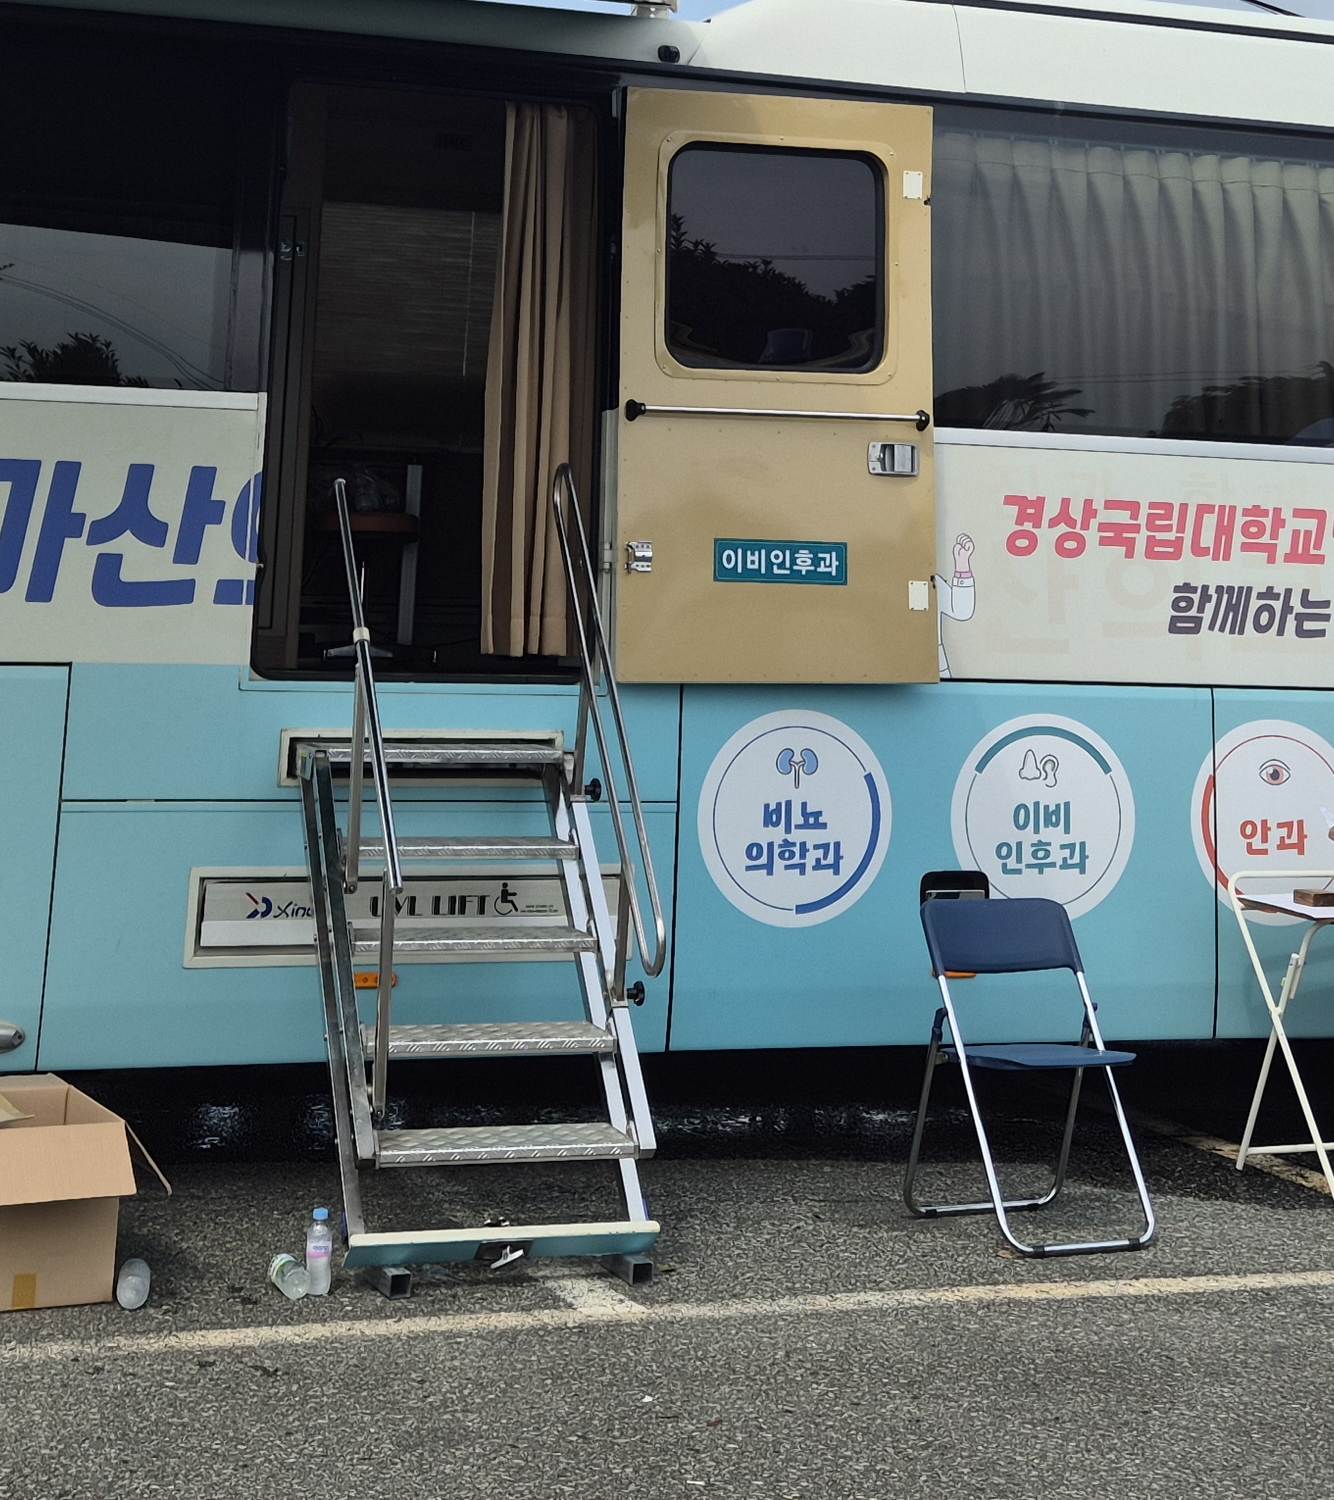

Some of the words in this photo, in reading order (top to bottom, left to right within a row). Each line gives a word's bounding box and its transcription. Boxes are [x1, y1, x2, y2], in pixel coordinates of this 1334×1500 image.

[721, 548, 839, 577] 이비인후과
[1167, 582, 1332, 639] 함께하는
[763, 801, 828, 834] 비뇨
[1013, 800, 1071, 835] 이비
[1239, 818, 1308, 856] 안과
[745, 839, 844, 876] 의학과
[995, 839, 1089, 875] 인후과
[431, 895, 491, 916] LIFT
